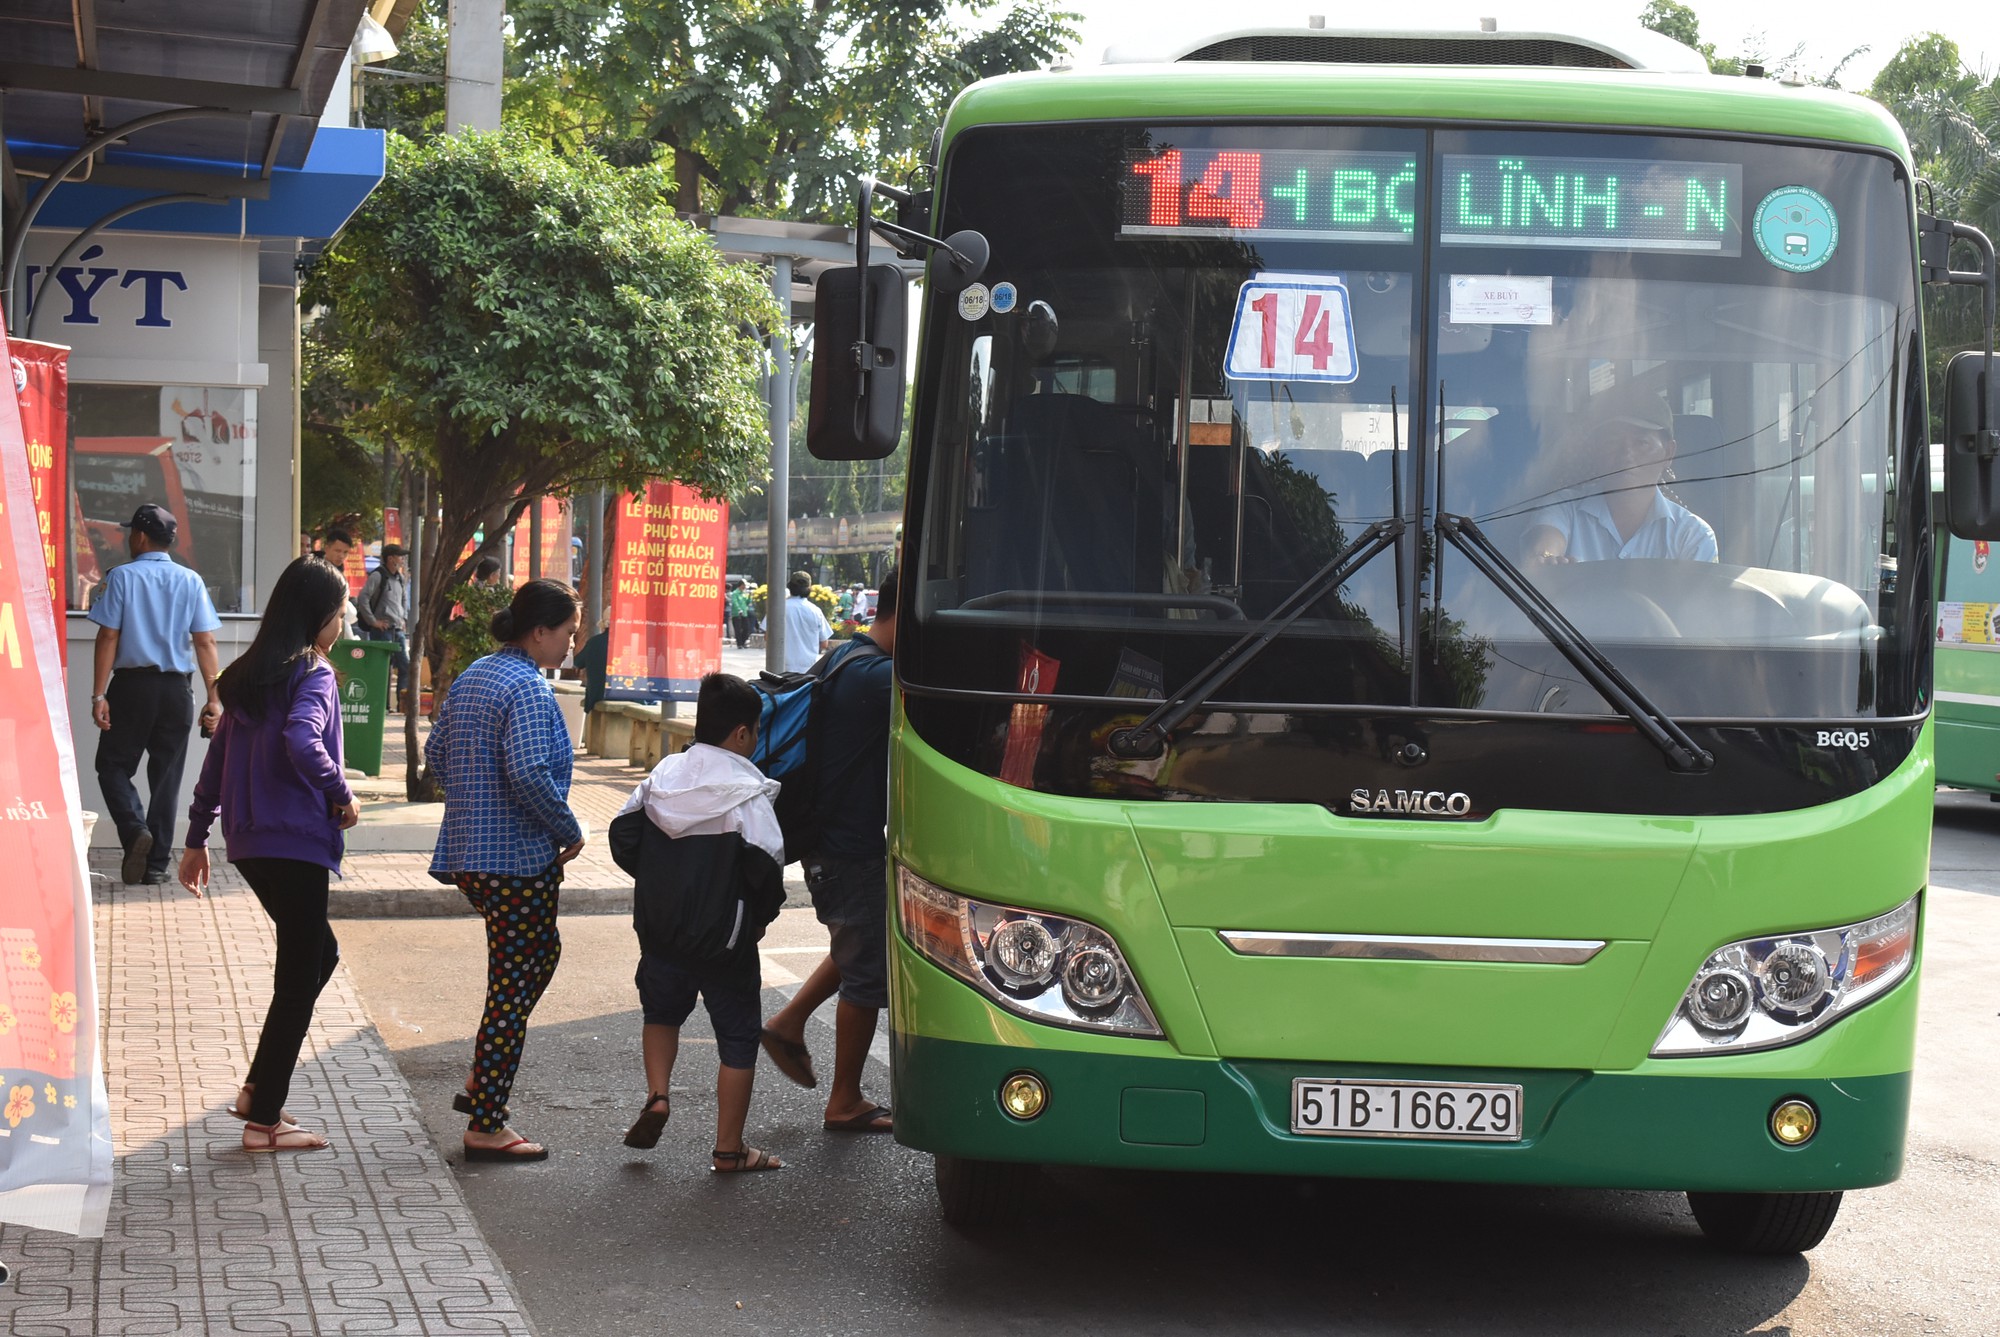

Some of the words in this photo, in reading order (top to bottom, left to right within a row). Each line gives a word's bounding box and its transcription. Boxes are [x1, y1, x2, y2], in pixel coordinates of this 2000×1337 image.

[1134, 150, 1264, 228] 14
[1459, 160, 1618, 229] LĨNH
[964, 296, 984, 304] 06/18
[1251, 293, 1334, 371] 14
[644, 503, 680, 520] PHÁT
[682, 505, 719, 523] ĐỘNG
[643, 523, 678, 541] PHỤC
[681, 526, 700, 542] VỤ
[627, 539, 665, 557] HÀNH
[667, 542, 714, 560] KHÁCH
[620, 557, 645, 575] TẾT
[647, 558, 664, 576] CỔ
[667, 561, 719, 579] TRUYỀN
[618, 578, 650, 597] MẬU
[653, 579, 687, 597] TUẤT
[689, 583, 718, 599] 2018
[1816, 731, 1870, 751] BGQ5
[1350, 788, 1471, 815] SAMCO
[1302, 1086, 1511, 1132] 51B-166.29
